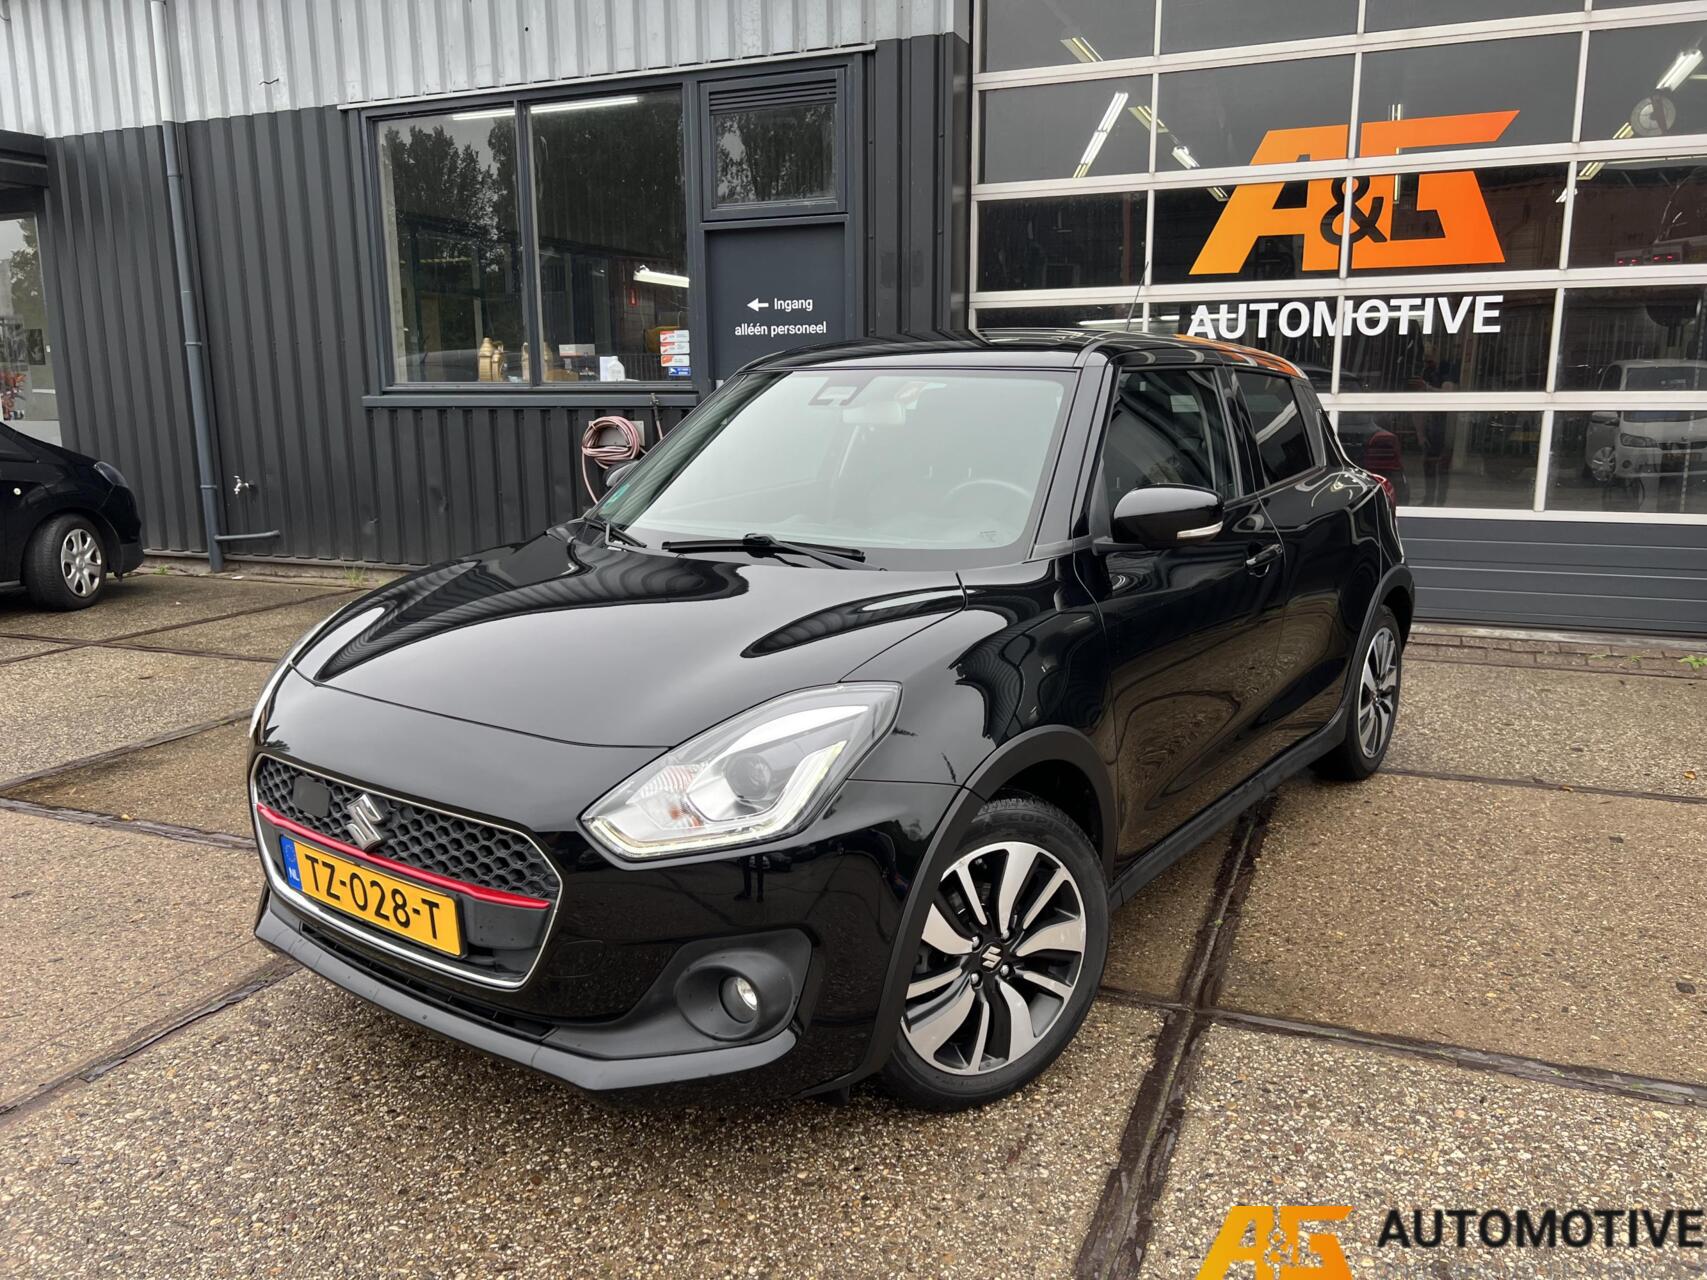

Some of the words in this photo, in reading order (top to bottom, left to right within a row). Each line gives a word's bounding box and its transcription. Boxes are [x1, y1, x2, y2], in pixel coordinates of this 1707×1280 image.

[774, 297, 813, 312] Ingang
[1187, 294, 1504, 340] AUTOMOTIVE
[735, 323, 768, 335] alléén
[770, 320, 827, 338] personeel
[288, 866, 300, 882] NL
[304, 853, 440, 940] TZ-028-T
